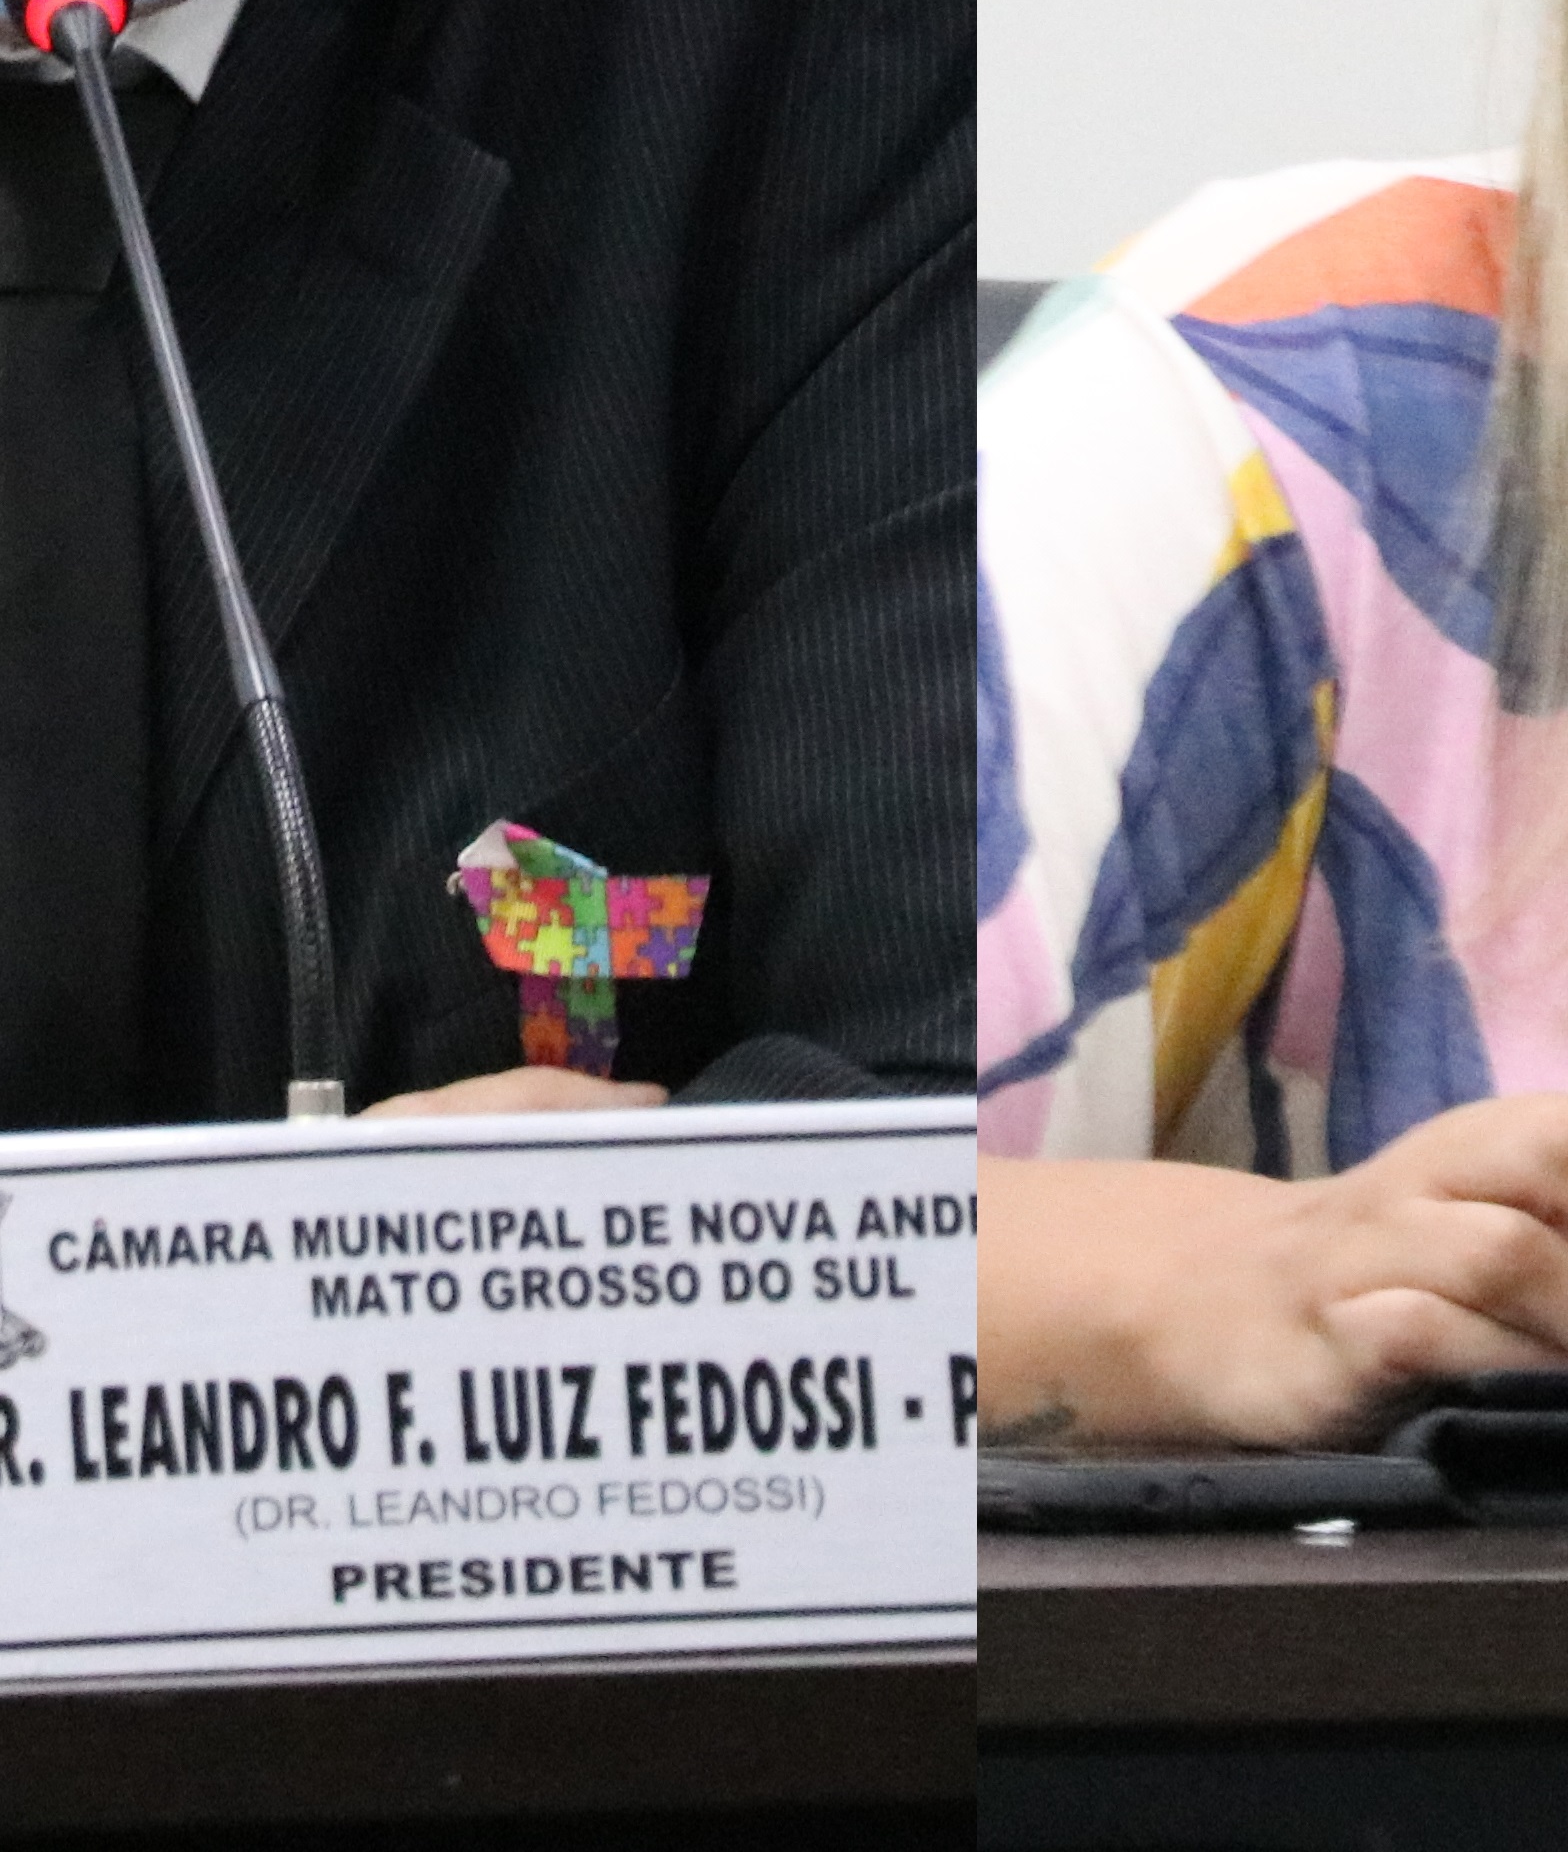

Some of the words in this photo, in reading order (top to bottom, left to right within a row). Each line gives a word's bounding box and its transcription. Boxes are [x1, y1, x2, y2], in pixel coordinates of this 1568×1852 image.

[47, 1219, 273, 1275] CÂMARA
[291, 1207, 585, 1260] MUNICIPAL
[602, 1203, 670, 1249] DE
[688, 1198, 837, 1245] NOVA
[855, 1193, 976, 1240] AND
[309, 1269, 462, 1318] MATO
[479, 1260, 702, 1313] GROSSO
[720, 1258, 793, 1305] DO
[812, 1255, 916, 1303] SUL
[69, 1373, 359, 1483] LEANDRO
[385, 1370, 436, 1467] F.
[458, 1364, 601, 1464] LUIZ
[624, 1355, 878, 1458] FEDOSSI
[233, 1492, 329, 1540] (DR.
[347, 1482, 582, 1529] LEANDRO
[595, 1473, 826, 1520] FEDOSSI)
[330, 1549, 739, 1604] PRESIDENTE
